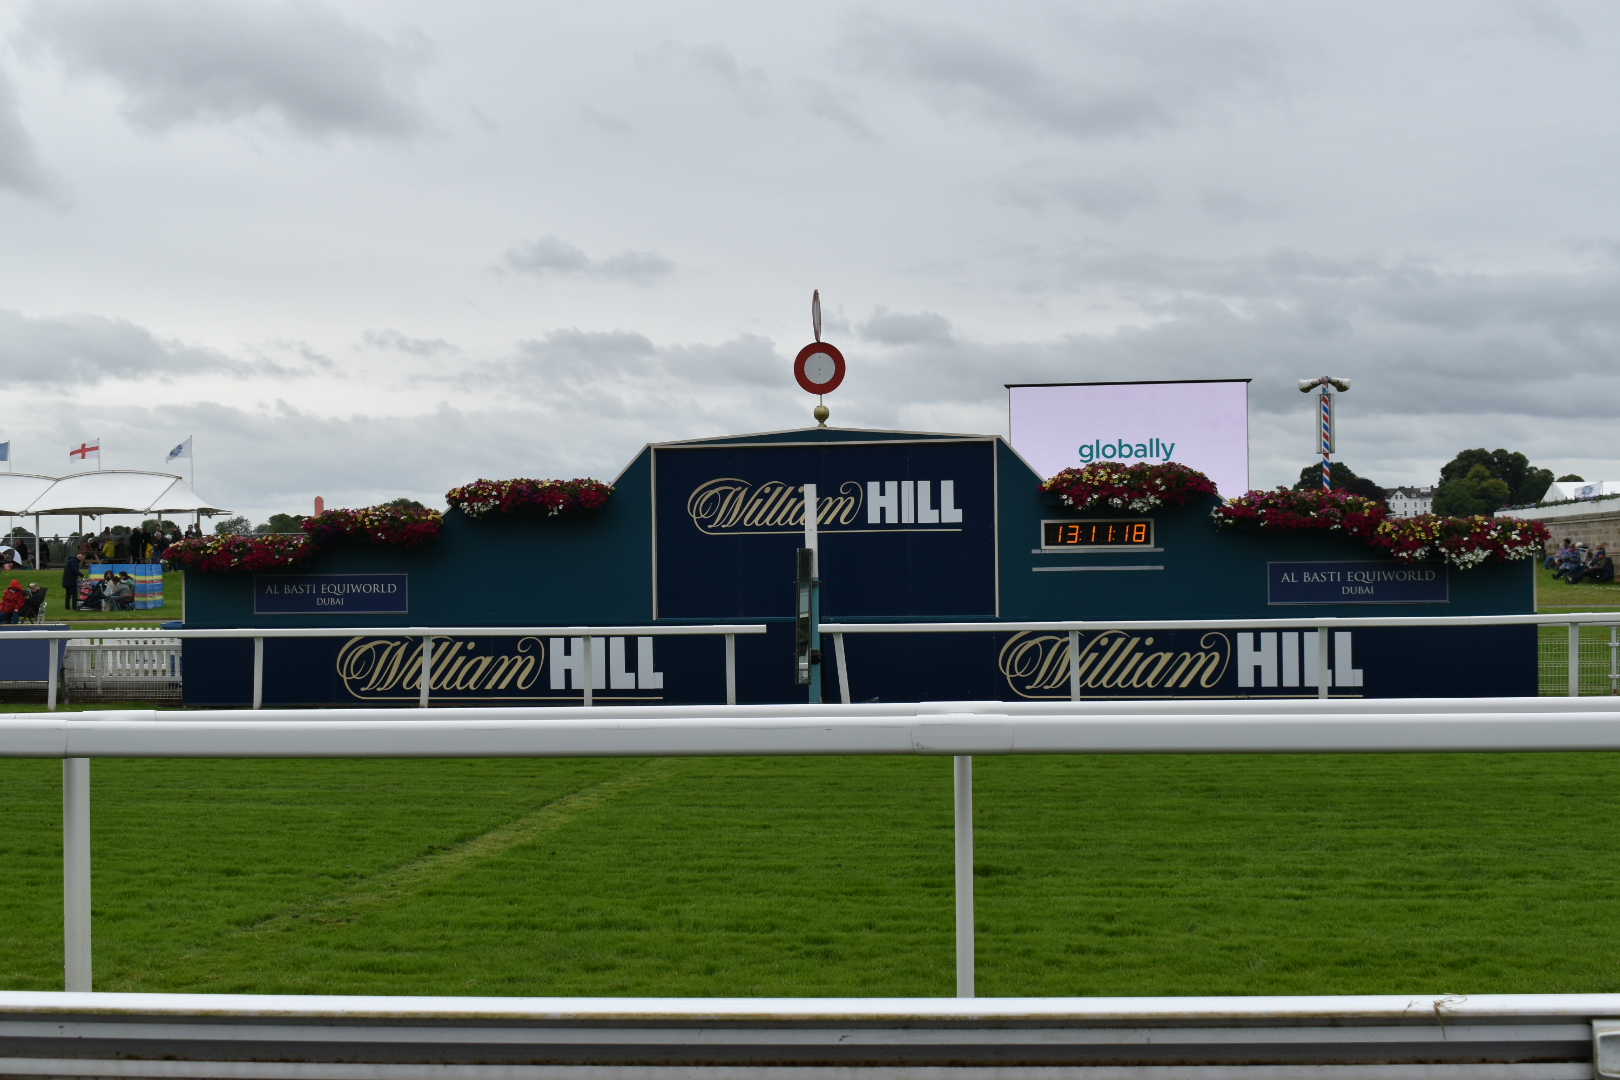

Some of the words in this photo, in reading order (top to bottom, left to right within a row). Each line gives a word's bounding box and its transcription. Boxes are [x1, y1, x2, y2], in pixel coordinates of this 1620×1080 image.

[1078, 438, 1176, 463] globally
[687, 478, 863, 534] William
[867, 480, 963, 523] HILL
[1058, 524, 1146, 544] 13:11:18
[1281, 572, 1298, 583] AL
[1303, 571, 1341, 583] BASTI
[1347, 570, 1436, 584] EQUIWORLD
[265, 585, 280, 595] AL
[284, 584, 316, 594] BASTI
[321, 583, 397, 596] EQUIWORLD
[1341, 586, 1374, 595] DUBAI
[316, 597, 344, 606] DUBAI
[336, 636, 545, 699] William
[550, 637, 664, 690] HILL
[999, 629, 1230, 698] William
[1237, 631, 1363, 688] HILL
